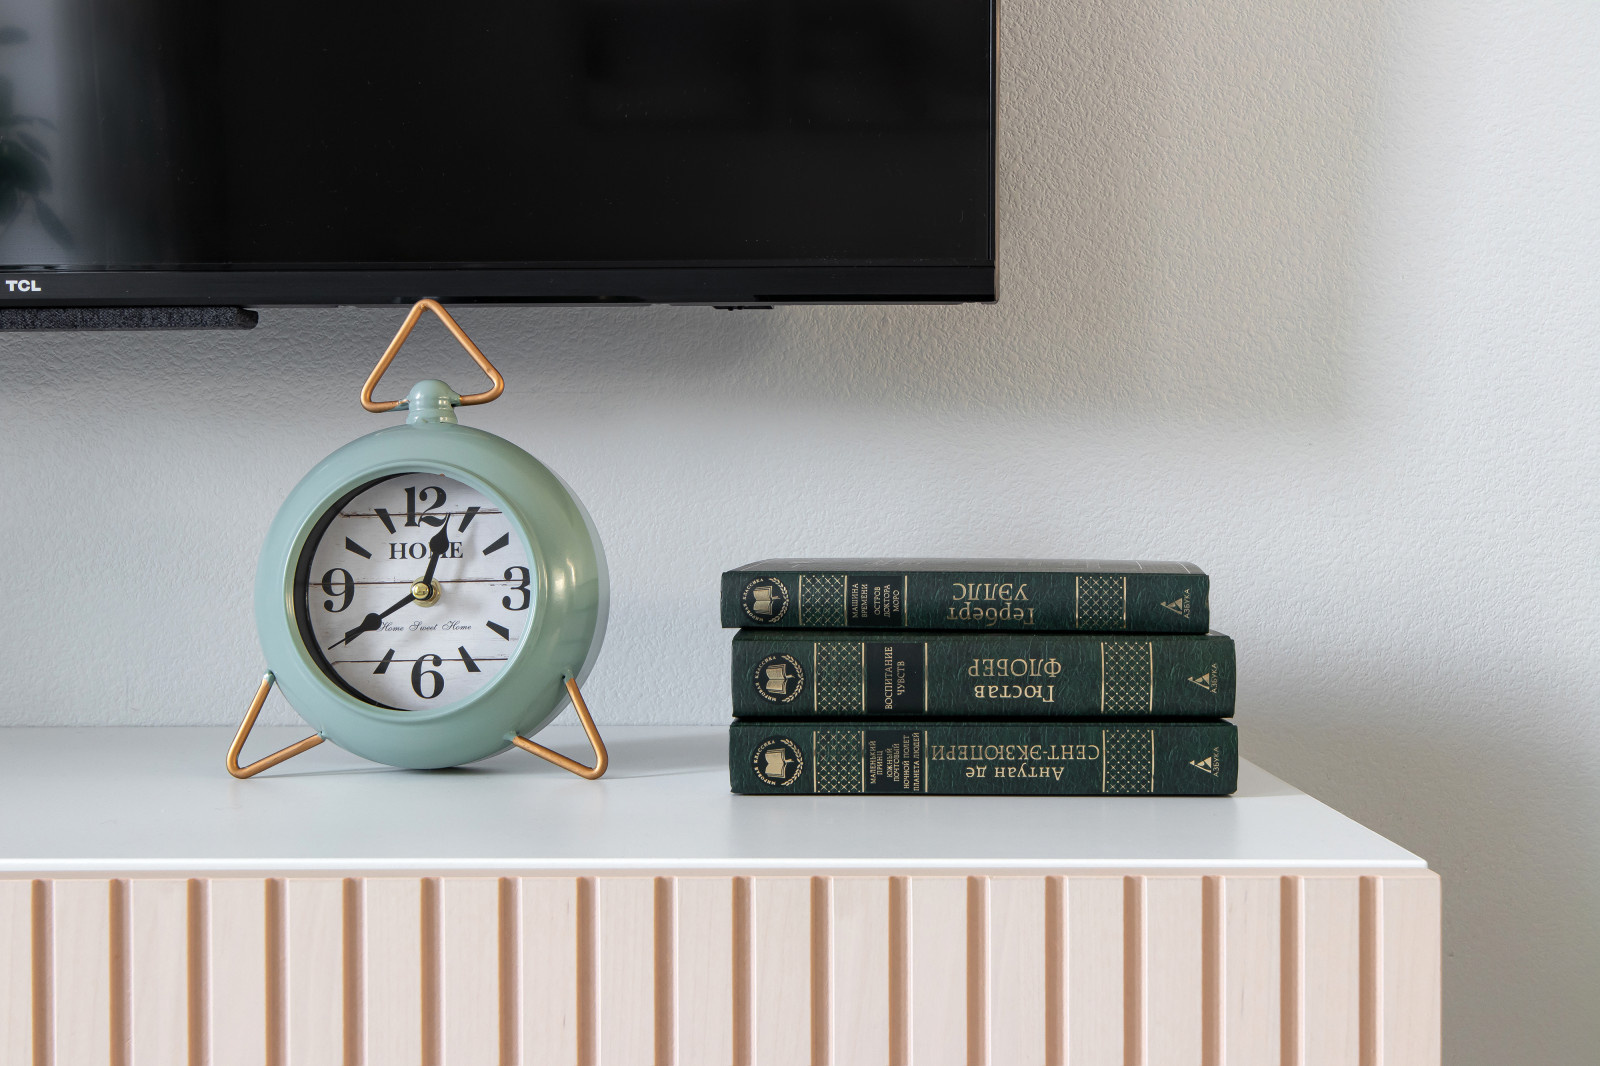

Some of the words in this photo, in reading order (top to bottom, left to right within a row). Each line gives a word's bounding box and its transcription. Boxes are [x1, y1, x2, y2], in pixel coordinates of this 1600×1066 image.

[5, 279, 42, 292] TCL
[404, 485, 447, 527] 12
[321, 567, 355, 612] 9
[502, 566, 531, 611] 3
[851, 583, 859, 618] МАШИНА
[883, 584, 891, 618] ДОКТОРА
[952, 583, 1029, 601] УЭЛЛС
[1183, 588, 1191, 619] АЗБУКА
[378, 621, 404, 632] Home
[409, 620, 438, 632] Sweet
[441, 620, 472, 631] Home
[946, 601, 1035, 627] Герберт
[411, 653, 445, 699] 6
[884, 646, 893, 710] ВОСПИТАНИЕ
[896, 660, 905, 696] ЧУВСТВ
[967, 658, 1062, 678] ФЛОБЕР
[1210, 663, 1218, 694] АЗБУКА
[974, 685, 1055, 703] Гюстав
[911, 732, 920, 759] ЛЮДЕЙ
[931, 744, 1100, 761] СЕНТ-ЭКЗЮПЕРИ
[868, 740, 877, 784] МАЛЕНЬКИЙ
[885, 748, 893, 778] ЮЖНЫЙ
[892, 743, 900, 782] ПОЧТОВЫЙ
[902, 760, 910, 789] НОЧНОЙ
[965, 765, 987, 779] де
[994, 762, 1065, 781] Антуан
